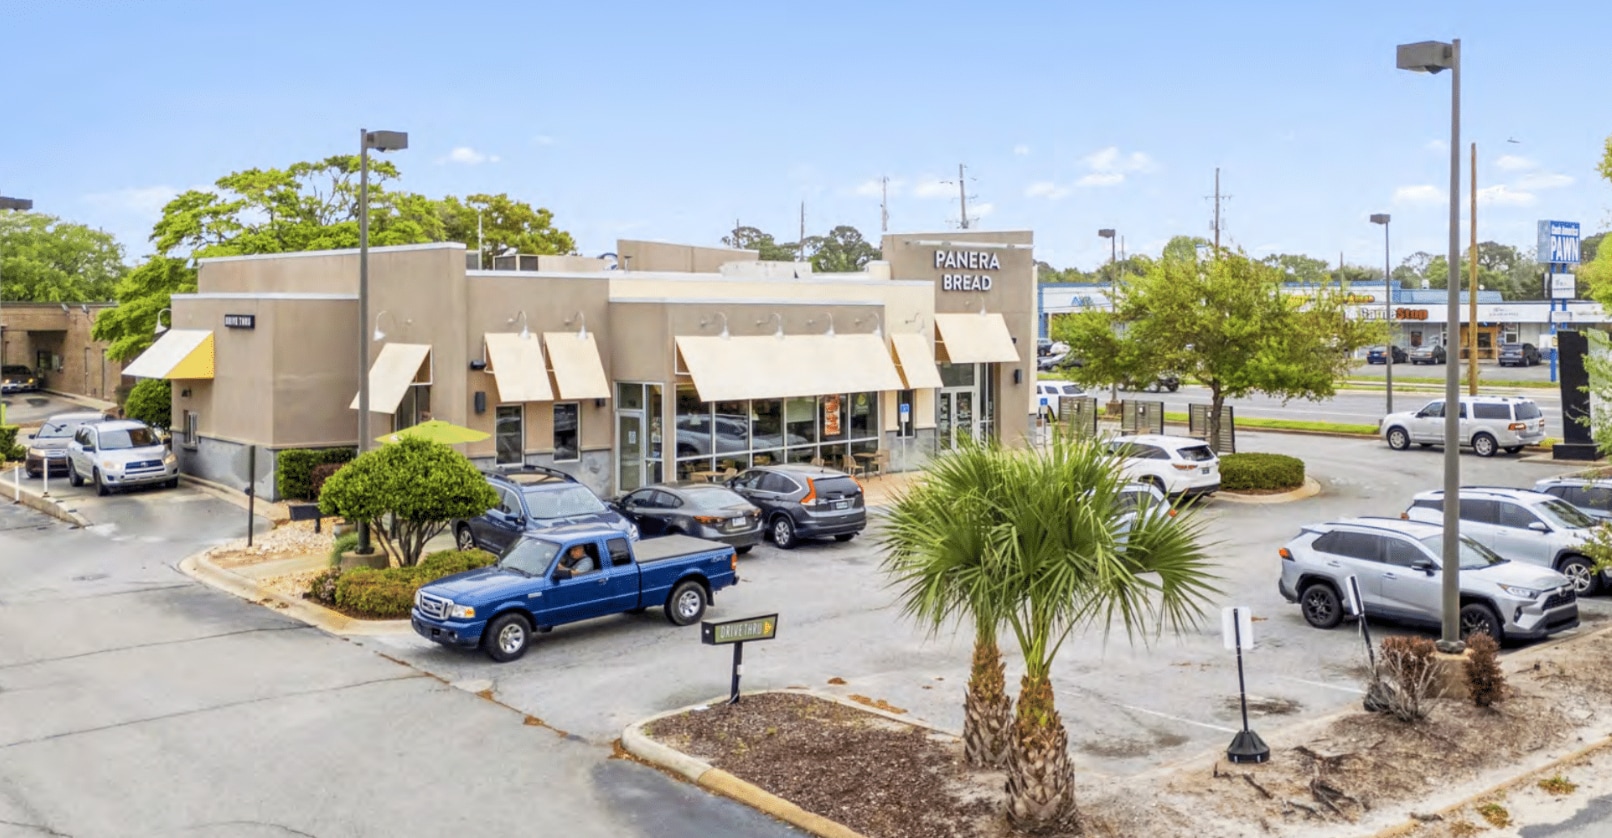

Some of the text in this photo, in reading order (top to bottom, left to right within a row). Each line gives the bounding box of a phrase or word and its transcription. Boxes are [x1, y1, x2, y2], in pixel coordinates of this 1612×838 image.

[1550, 235, 1579, 261] PAWN
[935, 250, 1000, 269] PANERA
[942, 274, 992, 291] BREAD
[1361, 307, 1428, 320] GameStop
[721, 622, 762, 638] DRIVE THRU
